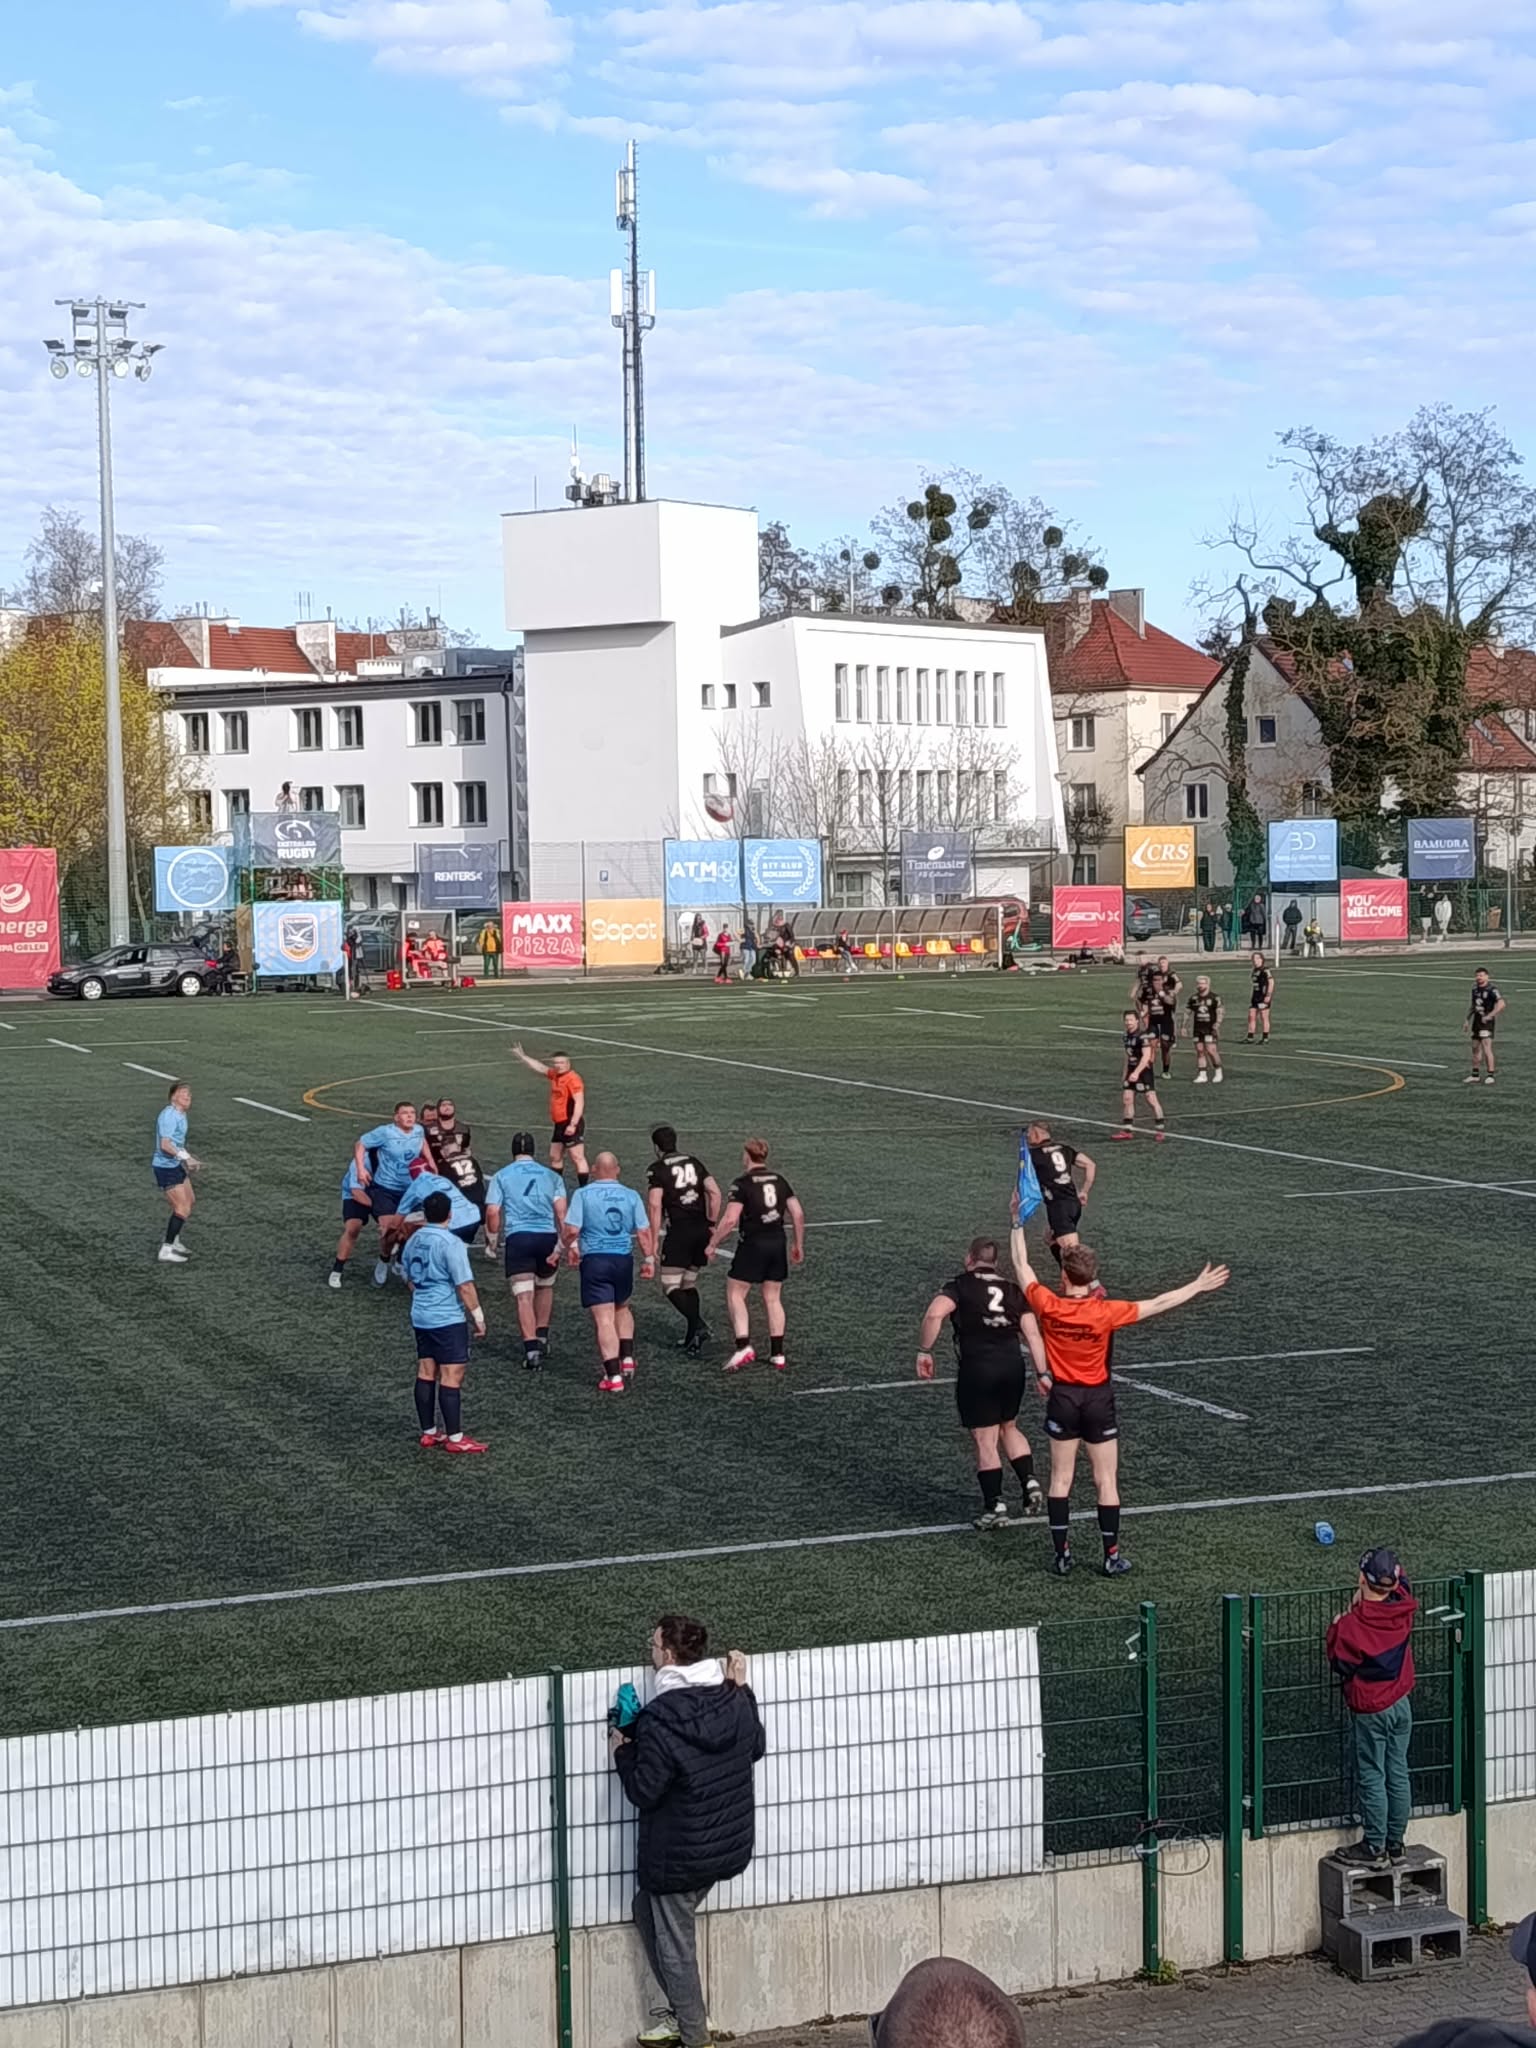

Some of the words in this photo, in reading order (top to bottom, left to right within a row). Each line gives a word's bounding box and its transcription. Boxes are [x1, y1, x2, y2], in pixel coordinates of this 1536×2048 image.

[1146, 843, 1190, 861] CRS
[1413, 839, 1469, 849] BAMUDRA
[277, 848, 317, 859] RUGBY
[434, 871, 477, 882] RENTERS
[670, 861, 717, 878] ATM
[1346, 905, 1404, 918] WELCOME
[512, 913, 573, 935] MAXX
[591, 918, 657, 946] Sopot
[451, 1159, 476, 1177] 12
[1051, 1151, 1067, 1173] 9
[671, 1163, 698, 1189] 24
[762, 1183, 777, 1208] 8
[987, 1286, 1005, 1313] 2
